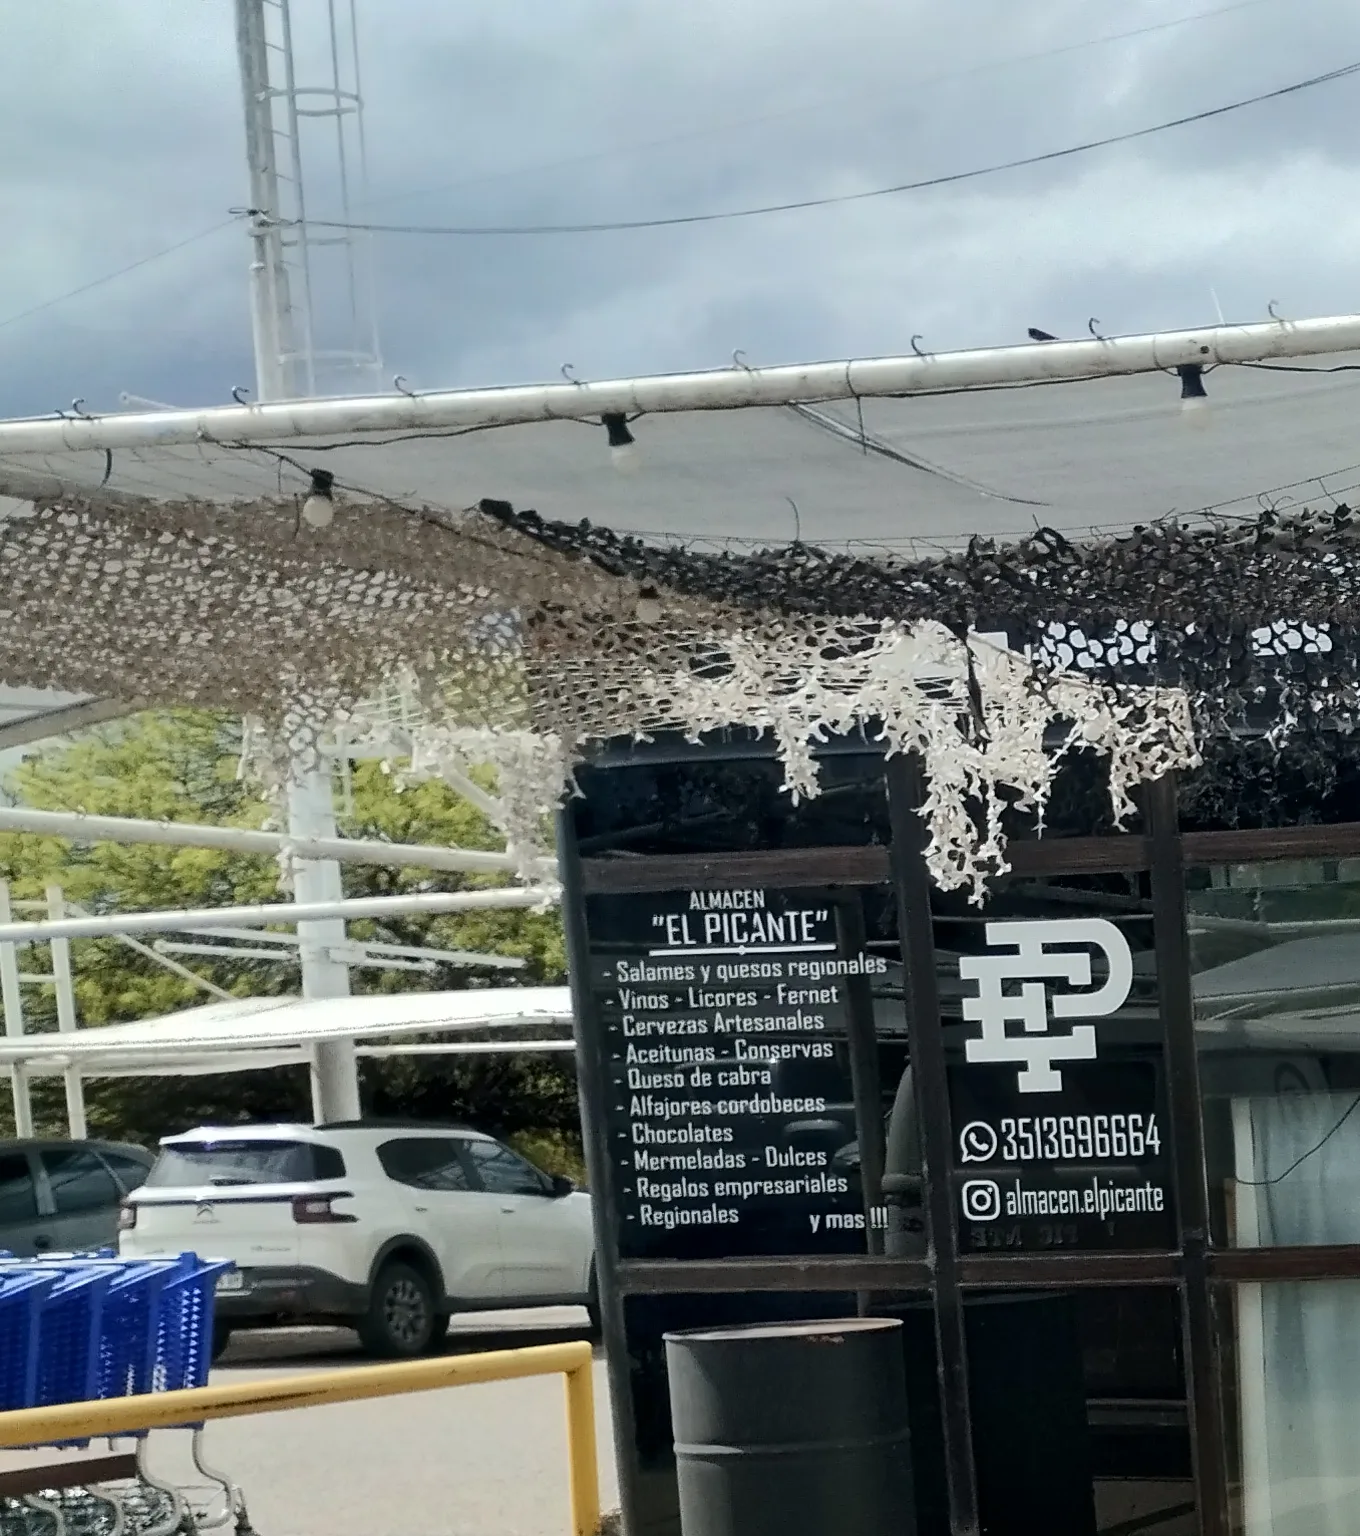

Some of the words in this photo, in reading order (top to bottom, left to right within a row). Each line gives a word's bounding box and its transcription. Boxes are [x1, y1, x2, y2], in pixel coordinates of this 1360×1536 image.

[690, 889, 765, 911] ALMACEN
[616, 960, 695, 983] Salames
[700, 964, 711, 984] y
[716, 961, 782, 982] quesos
[788, 951, 888, 980] regionales
[618, 987, 669, 1010] Vinos
[688, 986, 758, 1009] Licores
[776, 983, 839, 1005] Fernet
[622, 1015, 709, 1037] Cervezas
[713, 1009, 825, 1034] Artesanales
[626, 1043, 715, 1065] Aceitunas
[734, 1038, 834, 1061] Conservas
[628, 1068, 685, 1090] Queso
[690, 1065, 713, 1088] de
[717, 1065, 772, 1086] cabra
[630, 1095, 712, 1120] Alfajores
[717, 1092, 826, 1115] cordobeces
[632, 1122, 734, 1145] Chocolates
[1001, 1114, 1162, 1162] 3513696664
[634, 1148, 746, 1172] Mermeladas
[765, 1145, 828, 1168] Dulces
[637, 1176, 709, 1201] Regalos
[714, 1172, 848, 1200] empresariales
[1005, 1178, 1165, 1221] almacen.elpicante
[640, 1203, 740, 1230] Regionales
[809, 1213, 820, 1233] y
[825, 1212, 865, 1230] mas
